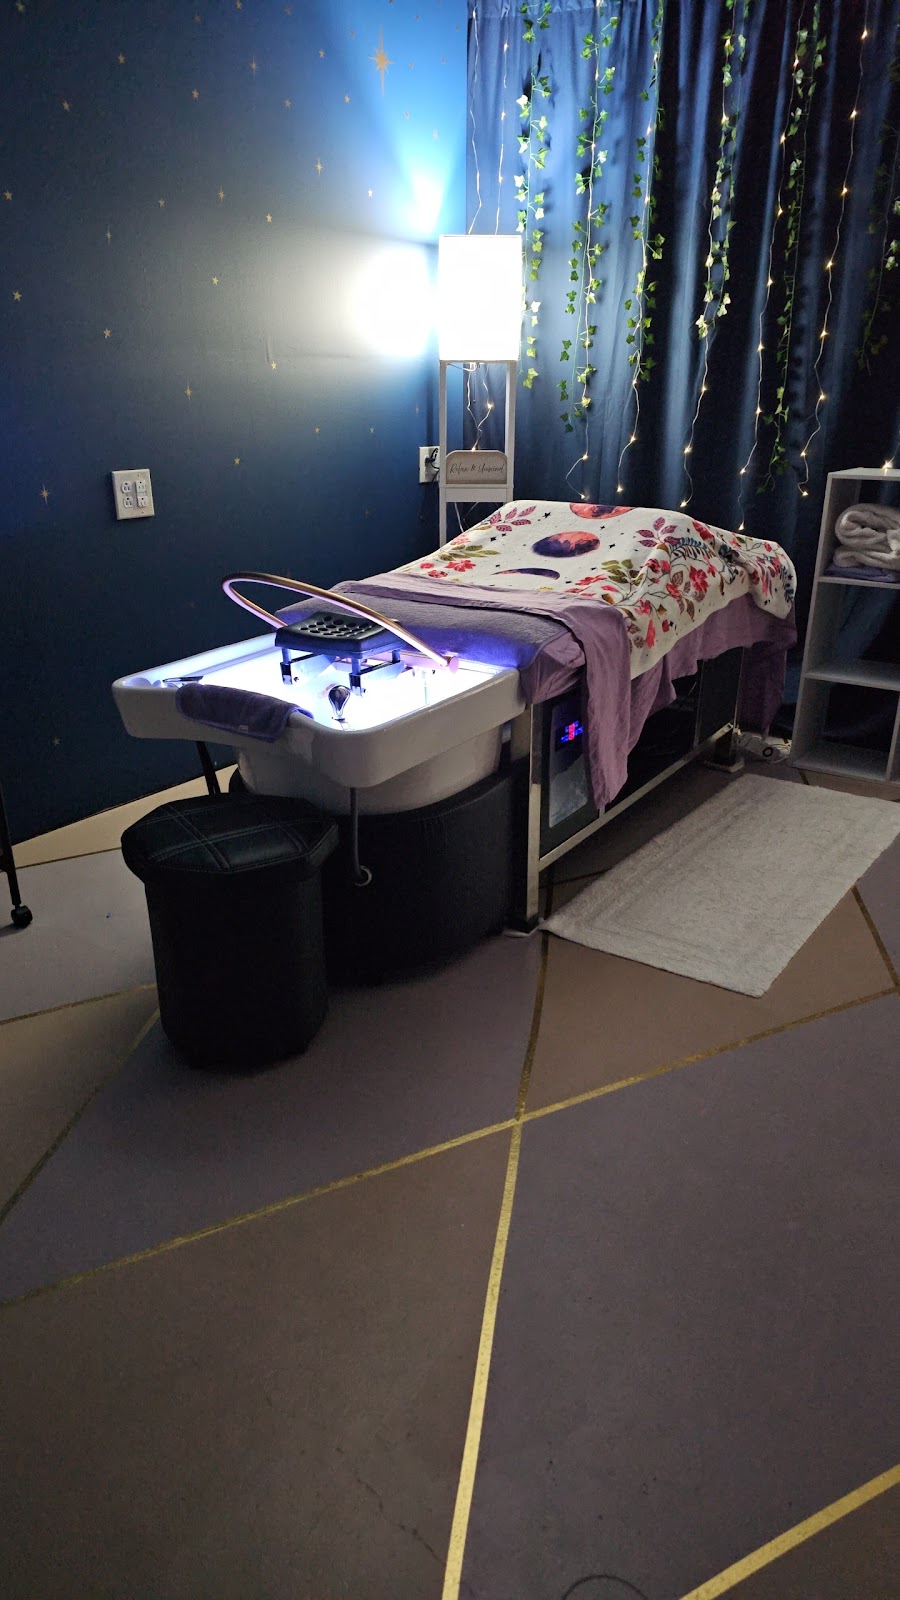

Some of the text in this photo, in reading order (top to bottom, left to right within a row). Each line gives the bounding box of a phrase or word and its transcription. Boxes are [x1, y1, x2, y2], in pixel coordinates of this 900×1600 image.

[449, 461, 505, 474] Relax & Unwind
